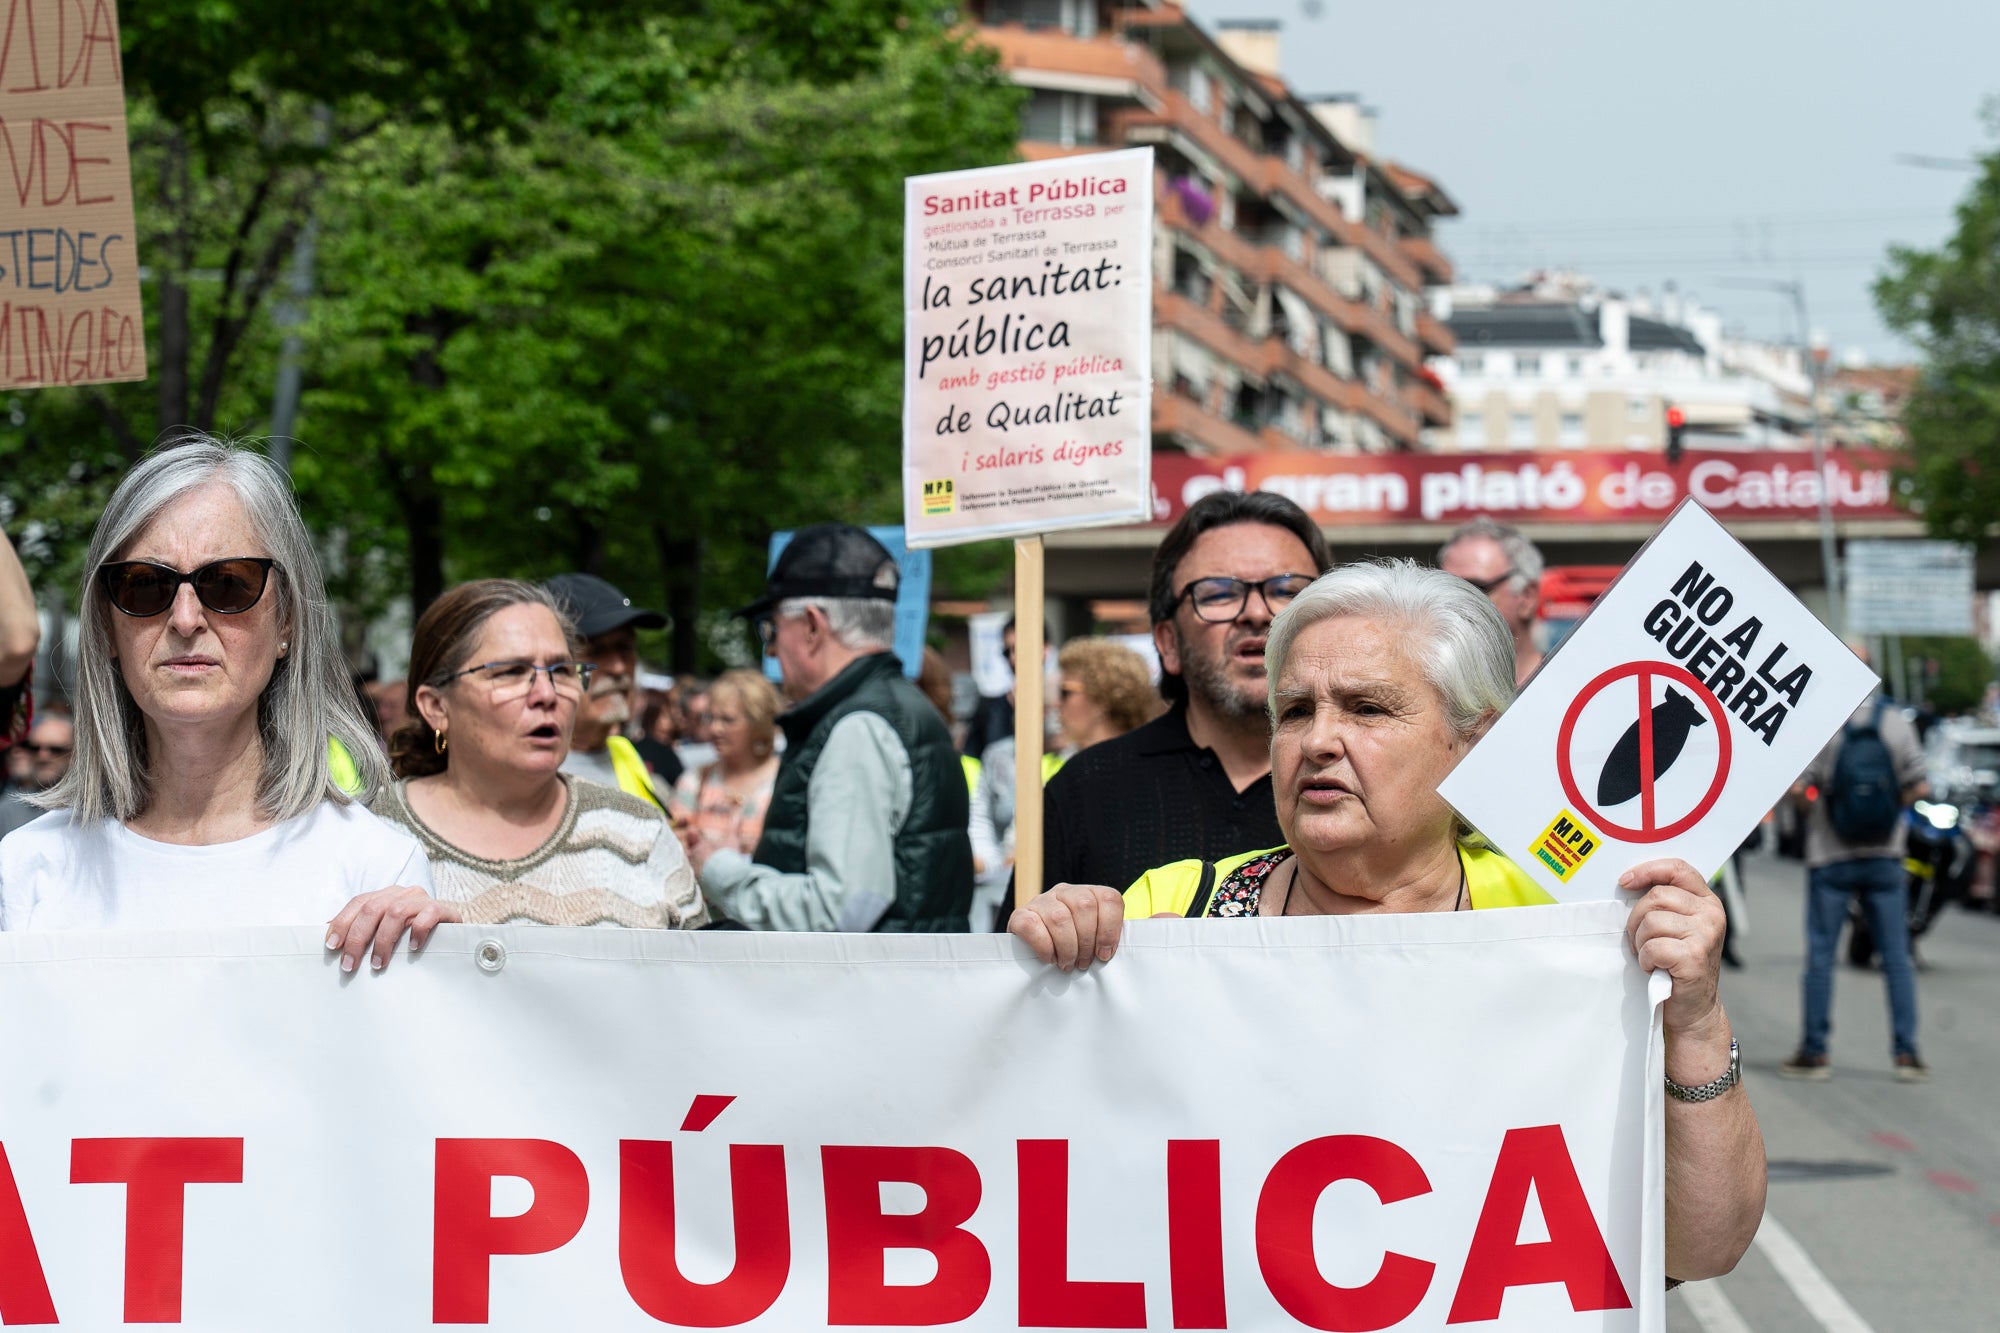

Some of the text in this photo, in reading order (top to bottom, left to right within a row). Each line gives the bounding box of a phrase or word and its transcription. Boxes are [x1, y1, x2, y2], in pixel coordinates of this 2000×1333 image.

[924, 177, 1127, 216] Sanitat Pública
[924, 202, 1125, 238] gestionada a Terrassa per
[974, 237, 987, 248] de
[992, 228, 1047, 245] Terrassa
[0, 227, 122, 294] TEDES
[988, 247, 1040, 263] Sanitari
[1043, 245, 1058, 256] de
[1063, 239, 1118, 255] Terrassa
[922, 258, 1122, 311] la sanitat:
[919, 314, 1070, 378] pública
[938, 355, 1123, 391] amb gestió pública
[936, 390, 1123, 436] de Qualitat
[961, 440, 1123, 472] i salaris dignes
[1421, 458, 1587, 521] plató
[1598, 461, 1677, 510] de
[1670, 560, 1813, 708] NO A LA
[1643, 599, 1788, 747] GUERRA
[1537, 848, 1565, 876] TERRASSA
[433, 1095, 1633, 1333] PÚBLICA
